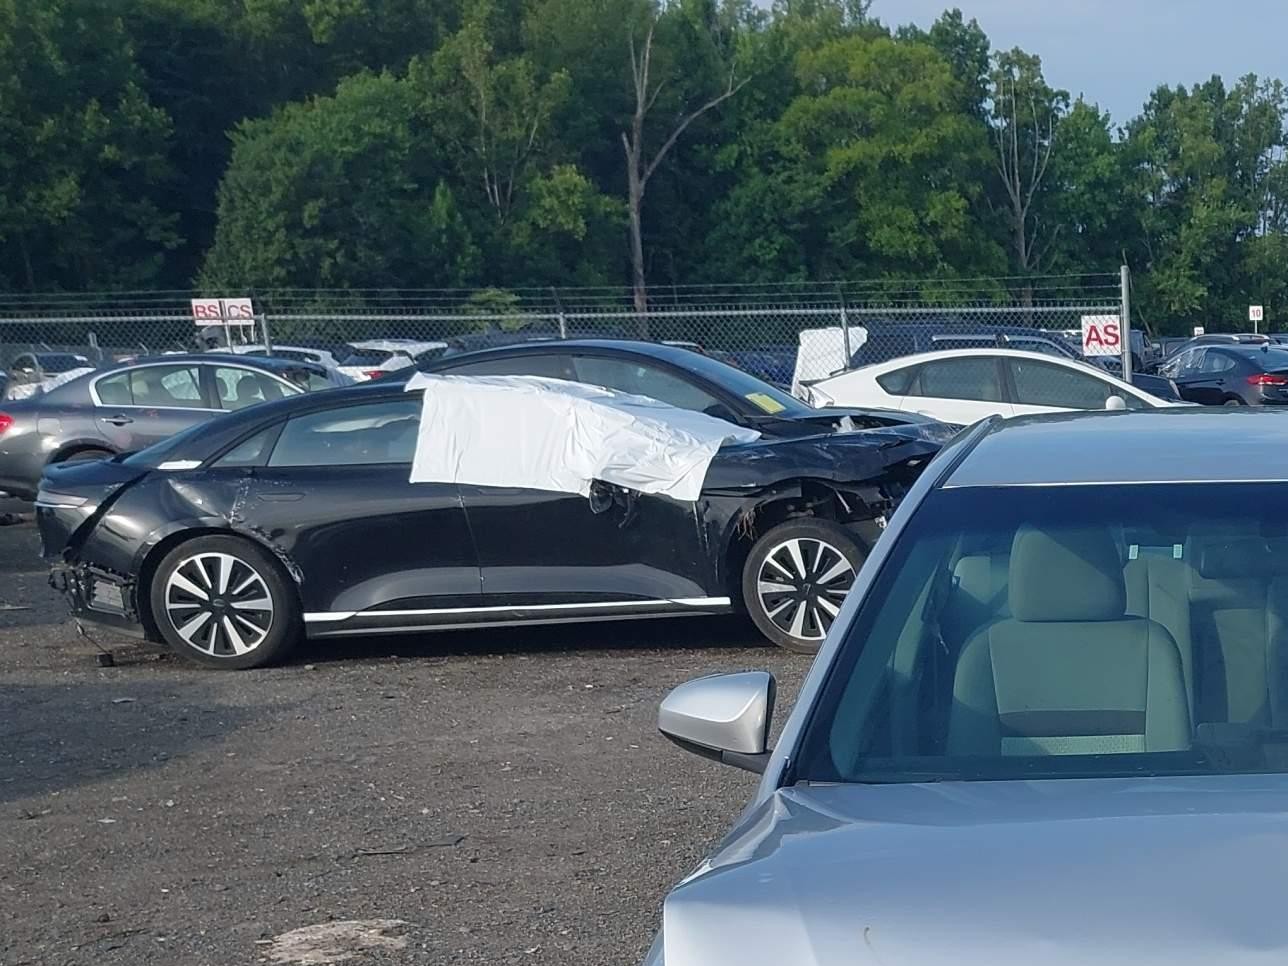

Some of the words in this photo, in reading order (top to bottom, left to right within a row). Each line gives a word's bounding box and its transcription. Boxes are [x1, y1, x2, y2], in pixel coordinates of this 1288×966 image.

[194, 304, 220, 319] BS
[227, 304, 252, 319] CS
[1251, 309, 1261, 318] 10
[1085, 324, 1120, 347] AS
